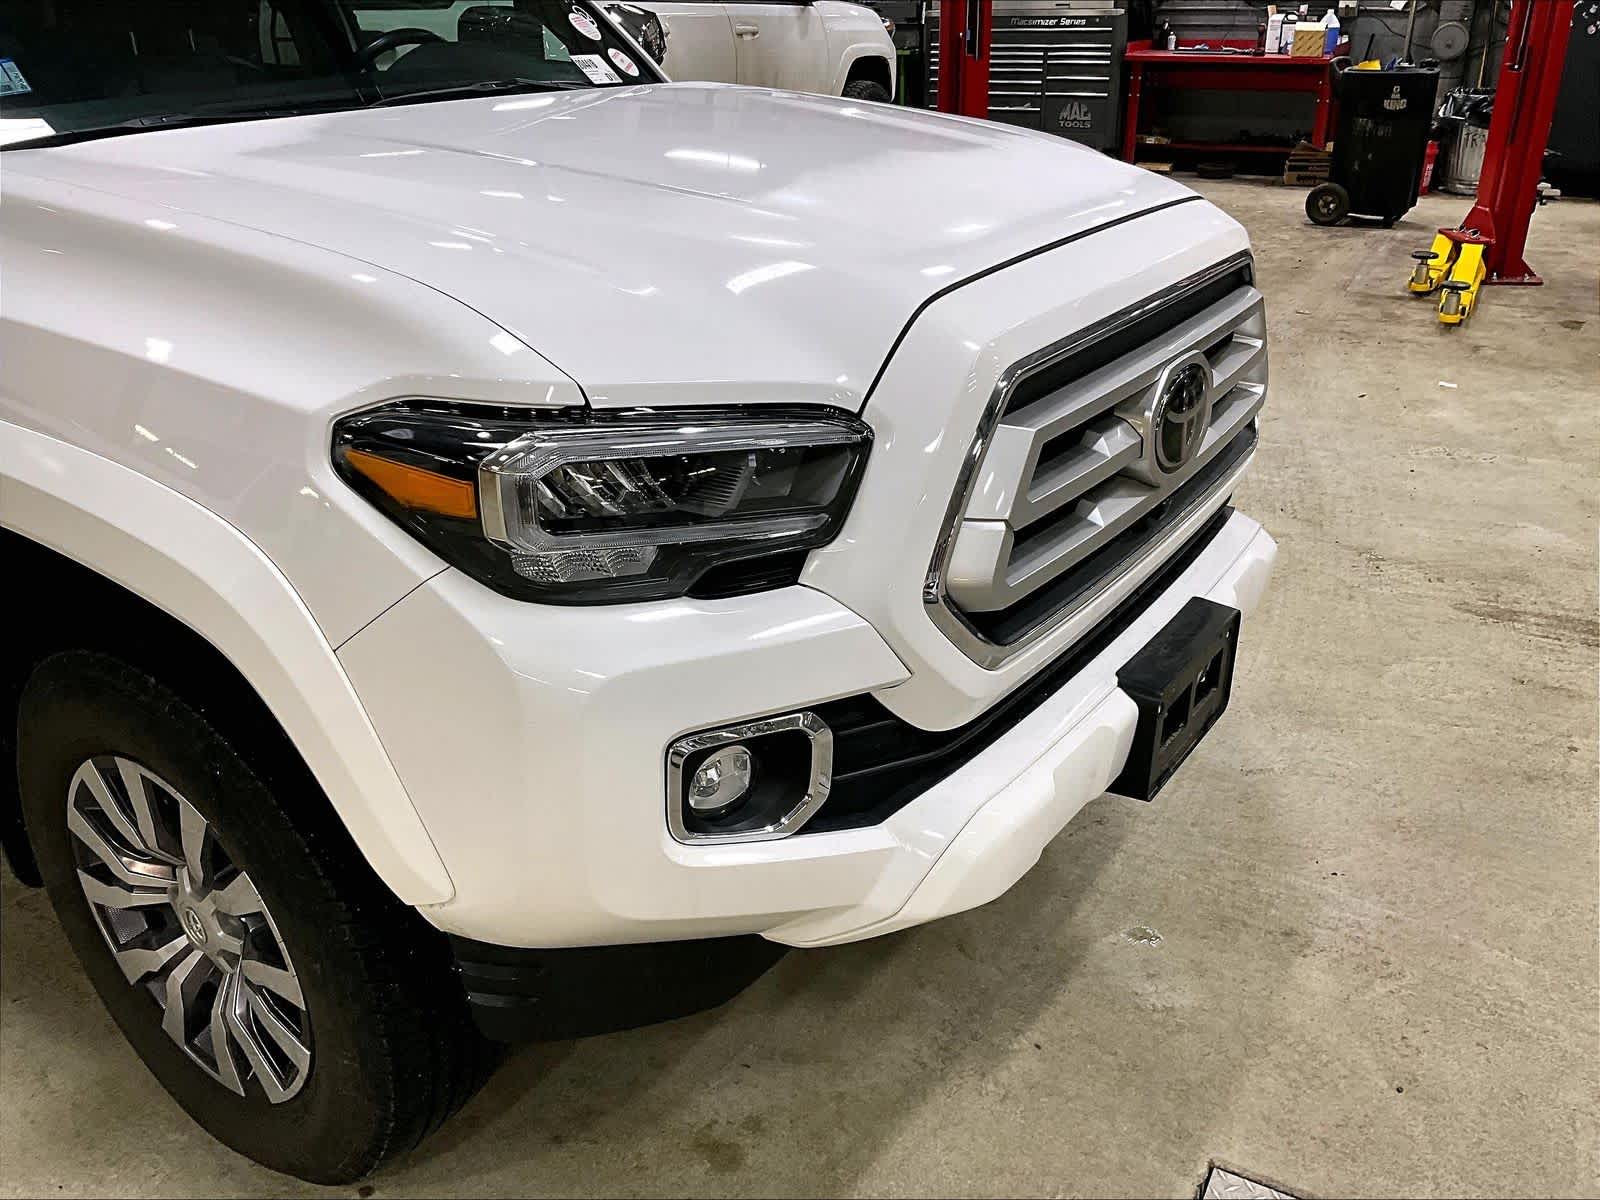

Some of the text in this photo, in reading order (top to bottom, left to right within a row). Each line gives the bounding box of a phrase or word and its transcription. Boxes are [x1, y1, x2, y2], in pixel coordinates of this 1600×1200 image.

[1060, 17, 1086, 26] Series
[1059, 102, 1092, 120] MAC
[1059, 120, 1092, 129] TOOLS
